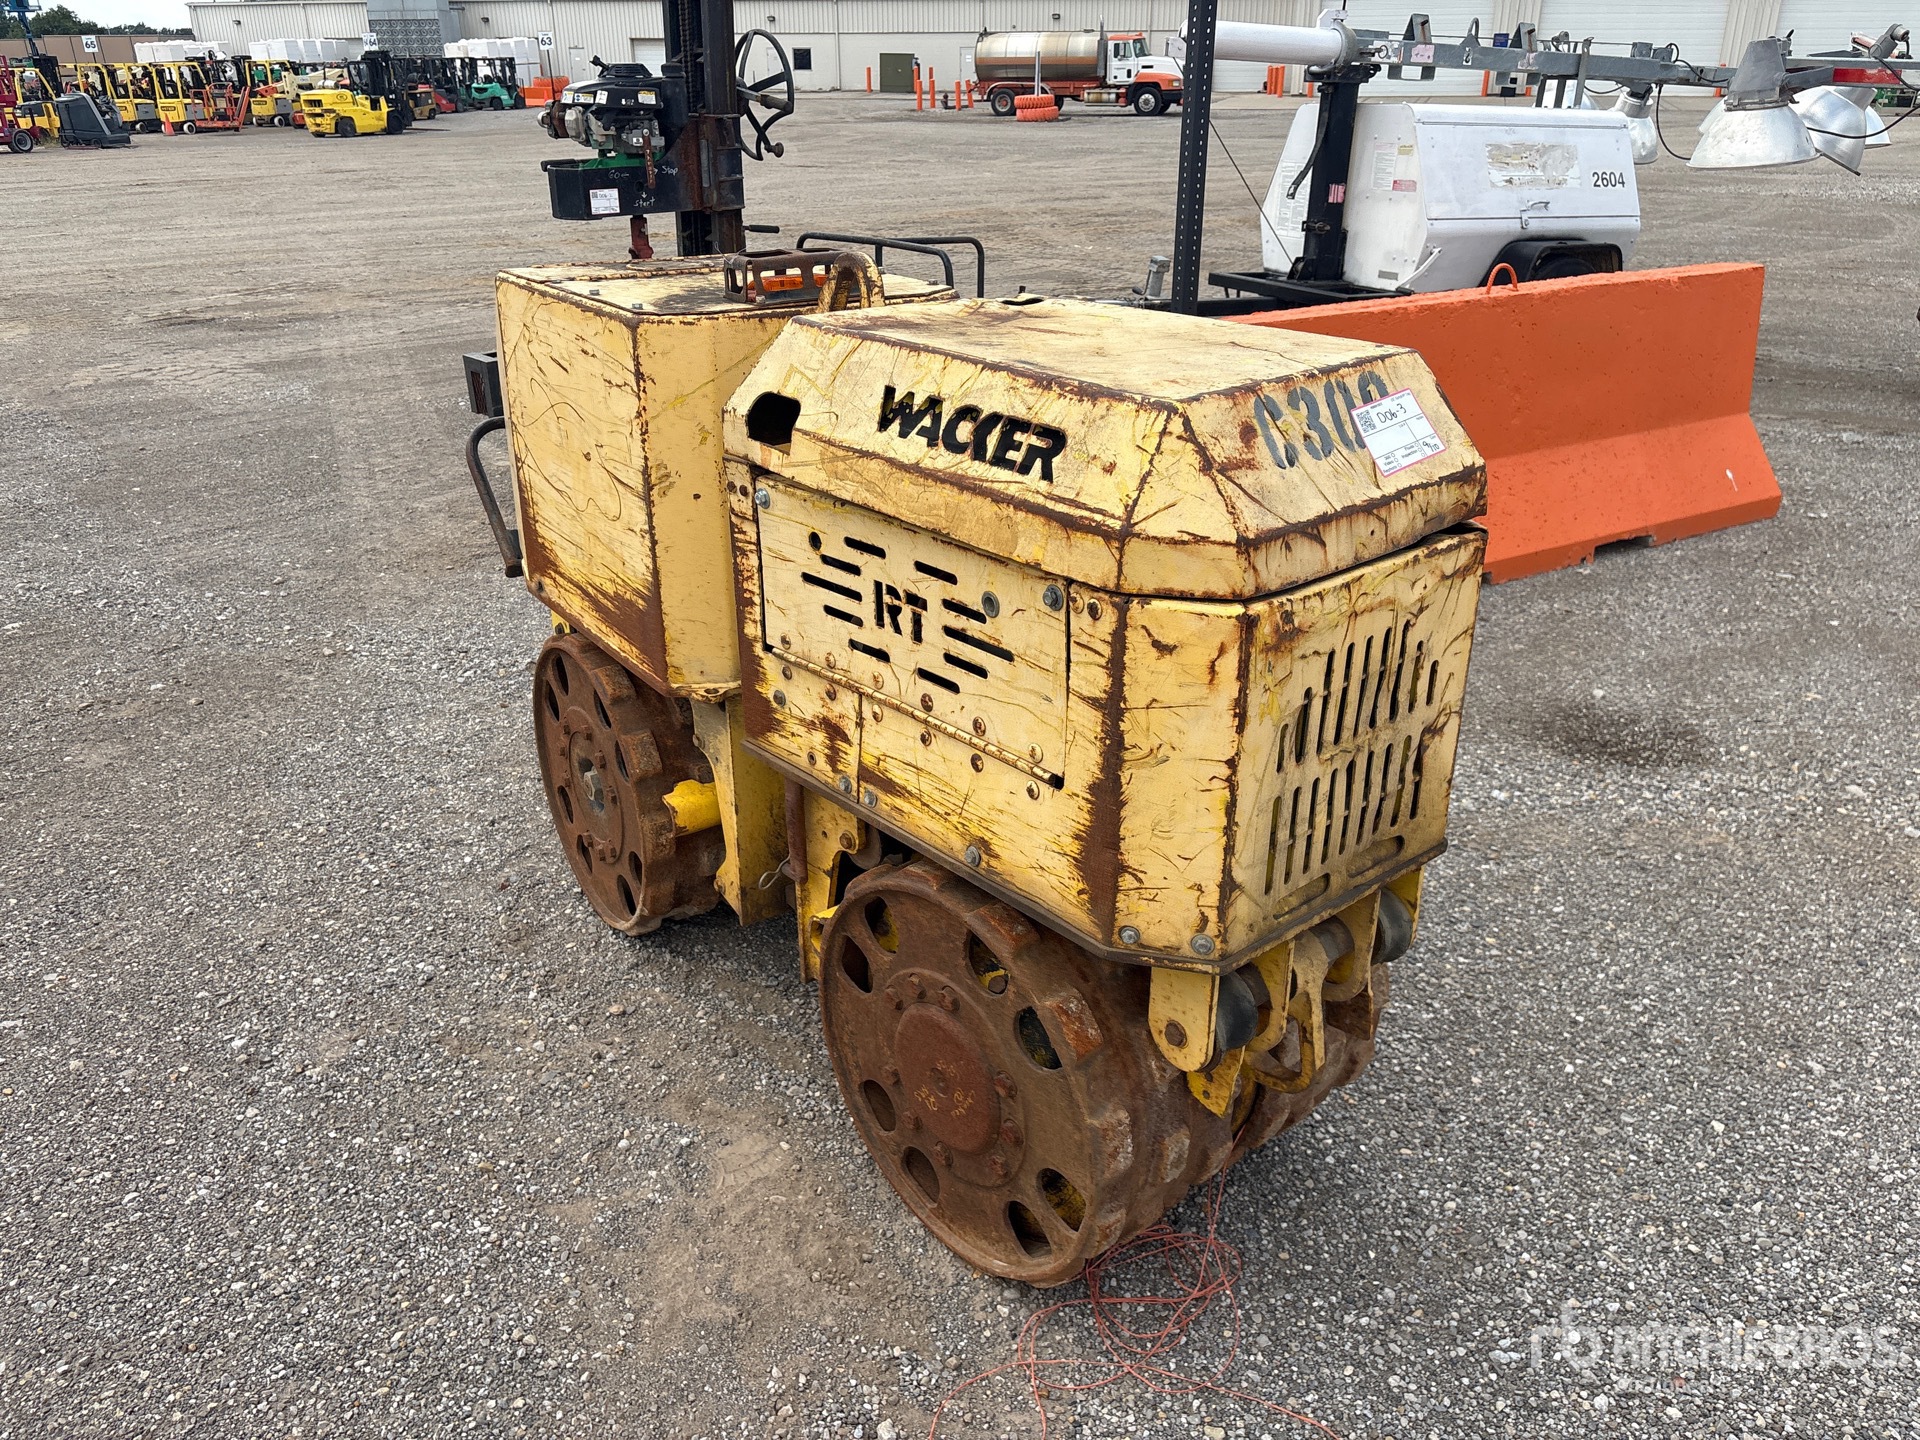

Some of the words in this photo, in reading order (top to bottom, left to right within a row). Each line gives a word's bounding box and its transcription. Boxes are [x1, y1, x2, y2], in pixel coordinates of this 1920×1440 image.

[85, 40, 96, 49] 65
[540, 36, 552, 46] 63
[661, 165, 679, 176] Stop
[1592, 171, 1626, 188] 2604
[877, 384, 1068, 484] WACKER
[873, 580, 928, 644] RT
